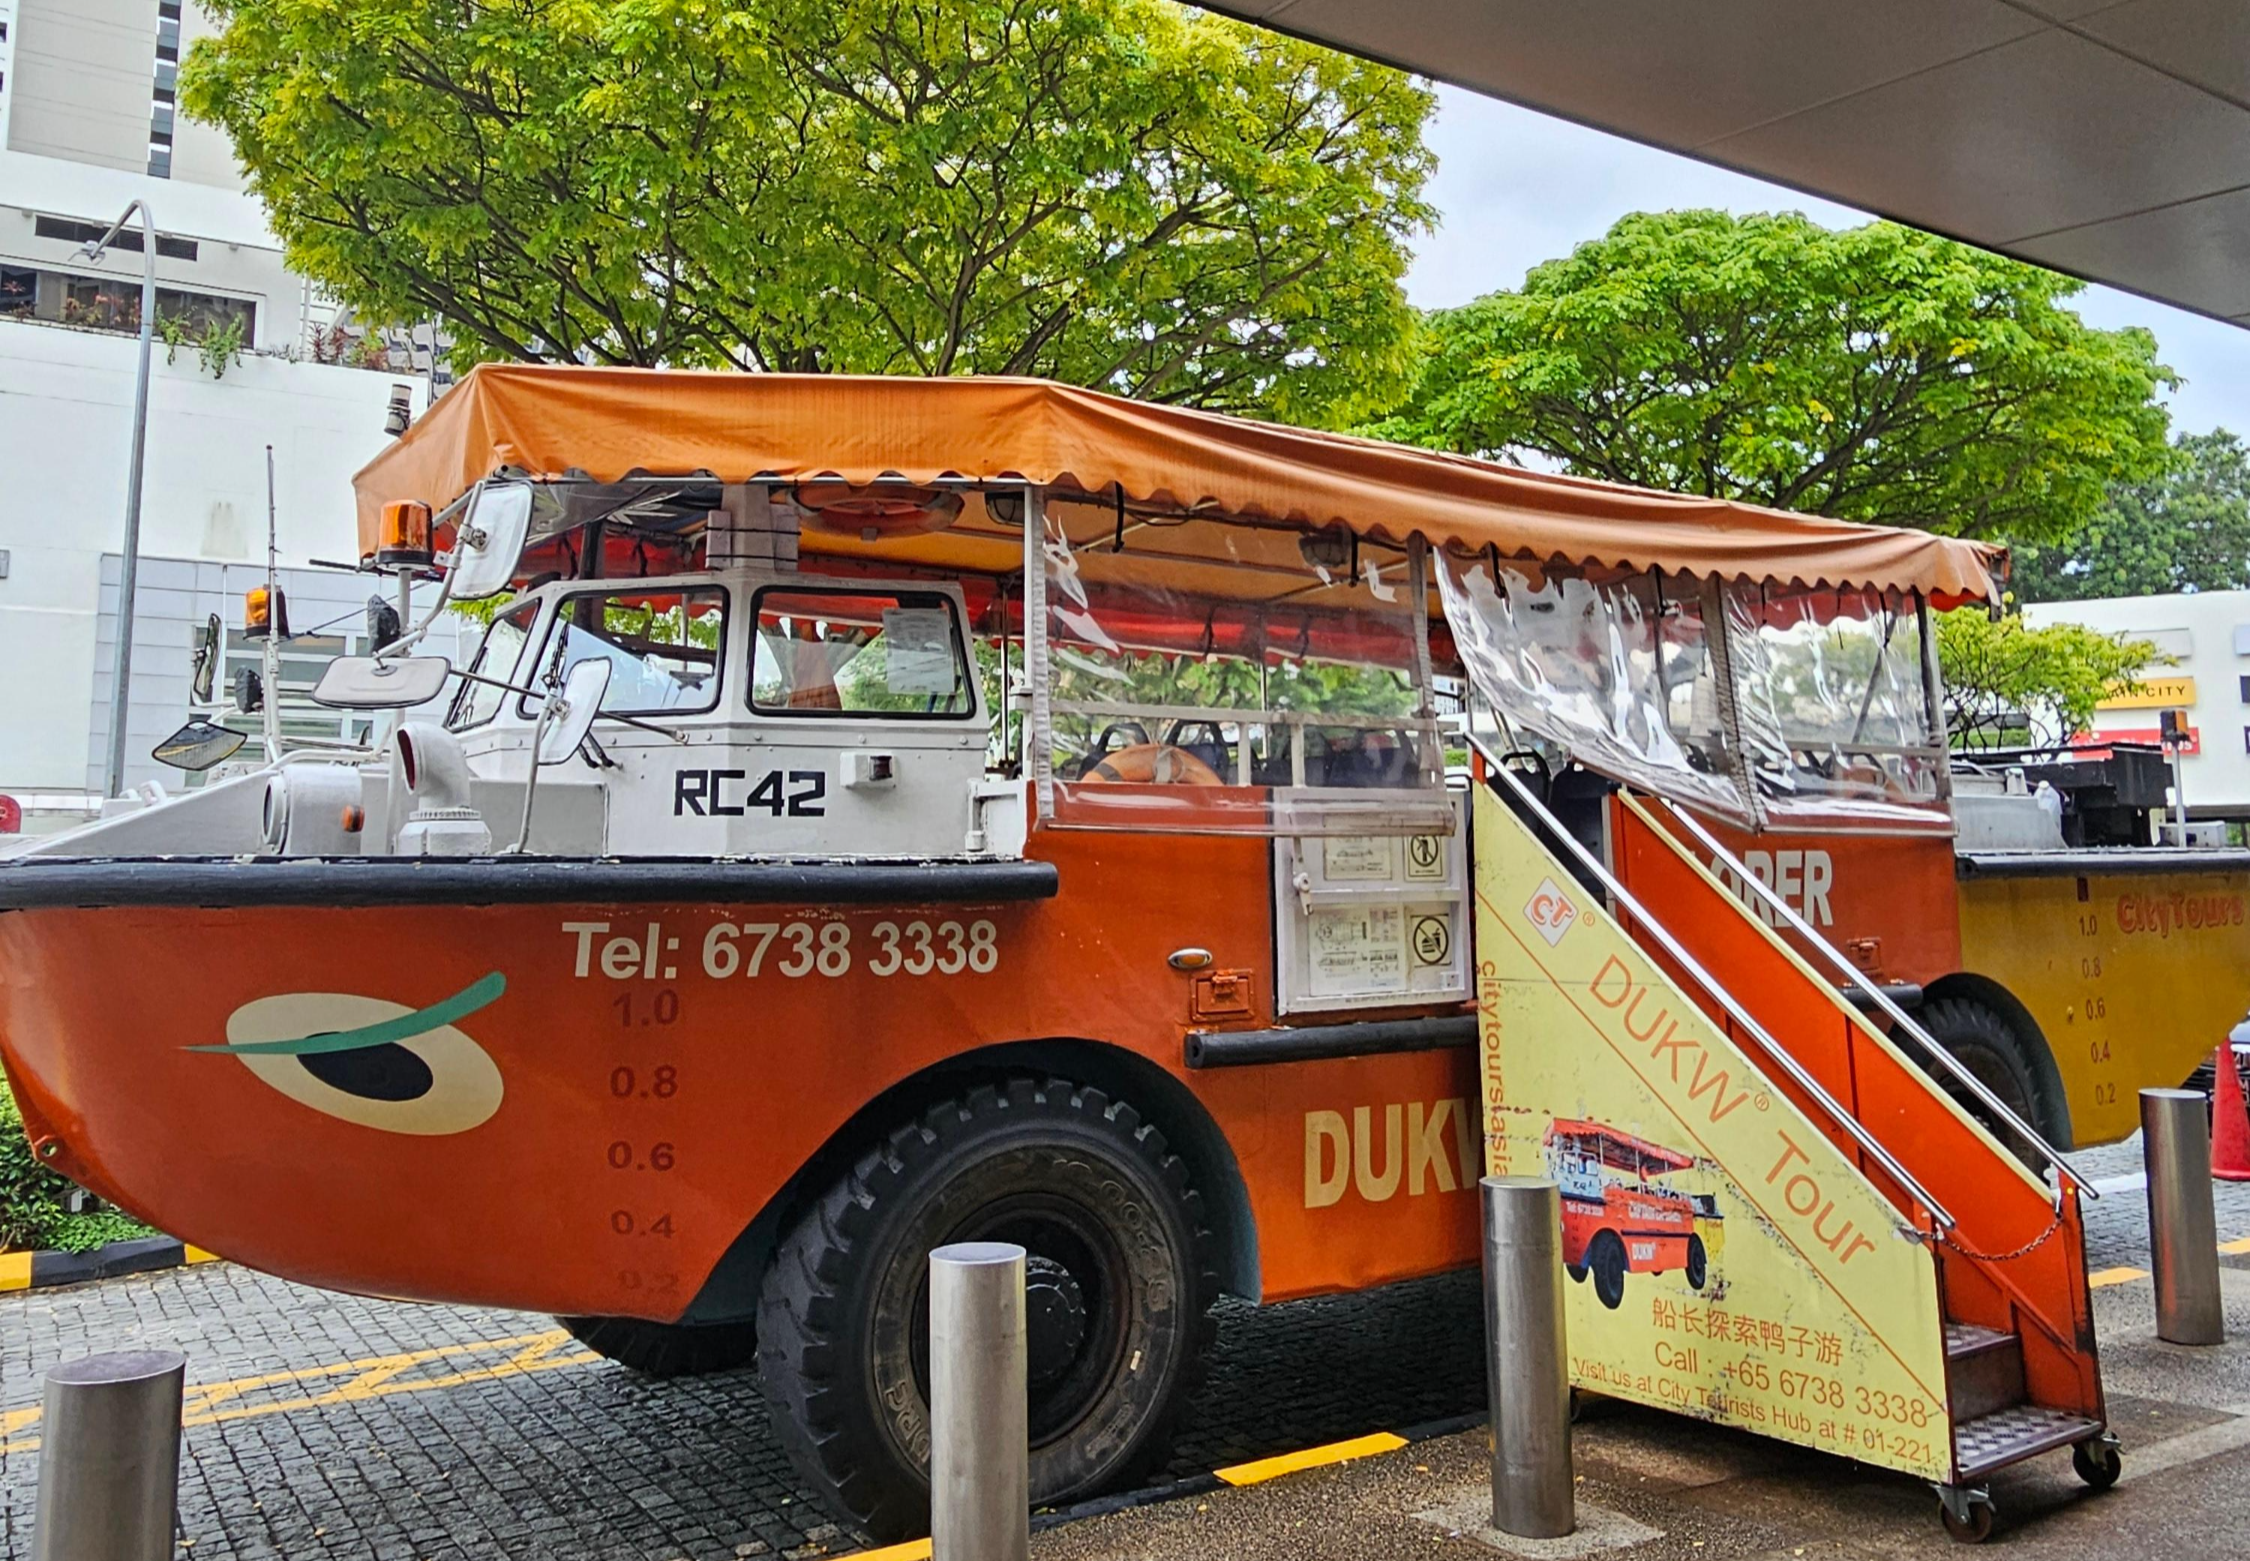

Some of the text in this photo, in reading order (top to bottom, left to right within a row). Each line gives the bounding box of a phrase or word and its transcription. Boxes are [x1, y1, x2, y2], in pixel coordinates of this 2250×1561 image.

[2146, 685, 2185, 698] CITY
[674, 770, 826, 817] RC42
[2078, 914, 2098, 937] 1.0
[2116, 892, 2245, 938] CityTours
[562, 919, 998, 979] Tel: 6738 3338
[2082, 957, 2101, 980] 0.8
[613, 988, 680, 1028] 1.0
[2086, 997, 2106, 1021] 0.6
[2090, 1040, 2111, 1064] 0.4
[609, 1064, 679, 1100] 0.8
[2095, 1083, 2116, 1106] 0.2
[607, 1140, 676, 1172] 0.6
[1765, 1129, 1877, 1265] Tour
[610, 1209, 676, 1239] 0.4
[1652, 1297, 1844, 1367] 船长探索鸭子游
[1655, 1341, 1698, 1374] Call
[1722, 1360, 1770, 1391] +65
[1779, 1369, 1845, 1409] 6738
[1855, 1386, 1928, 1429] 3338
[1573, 1357, 1608, 1382] Visit
[1613, 1370, 1632, 1388] us
[1637, 1375, 1652, 1393] at
[1658, 1378, 1691, 1403] City
[1695, 1386, 1766, 1422] Tourists
[1772, 1405, 1811, 1433] Hub
[1819, 1420, 1836, 1441] at
[1863, 1428, 1931, 1464] 01-221
